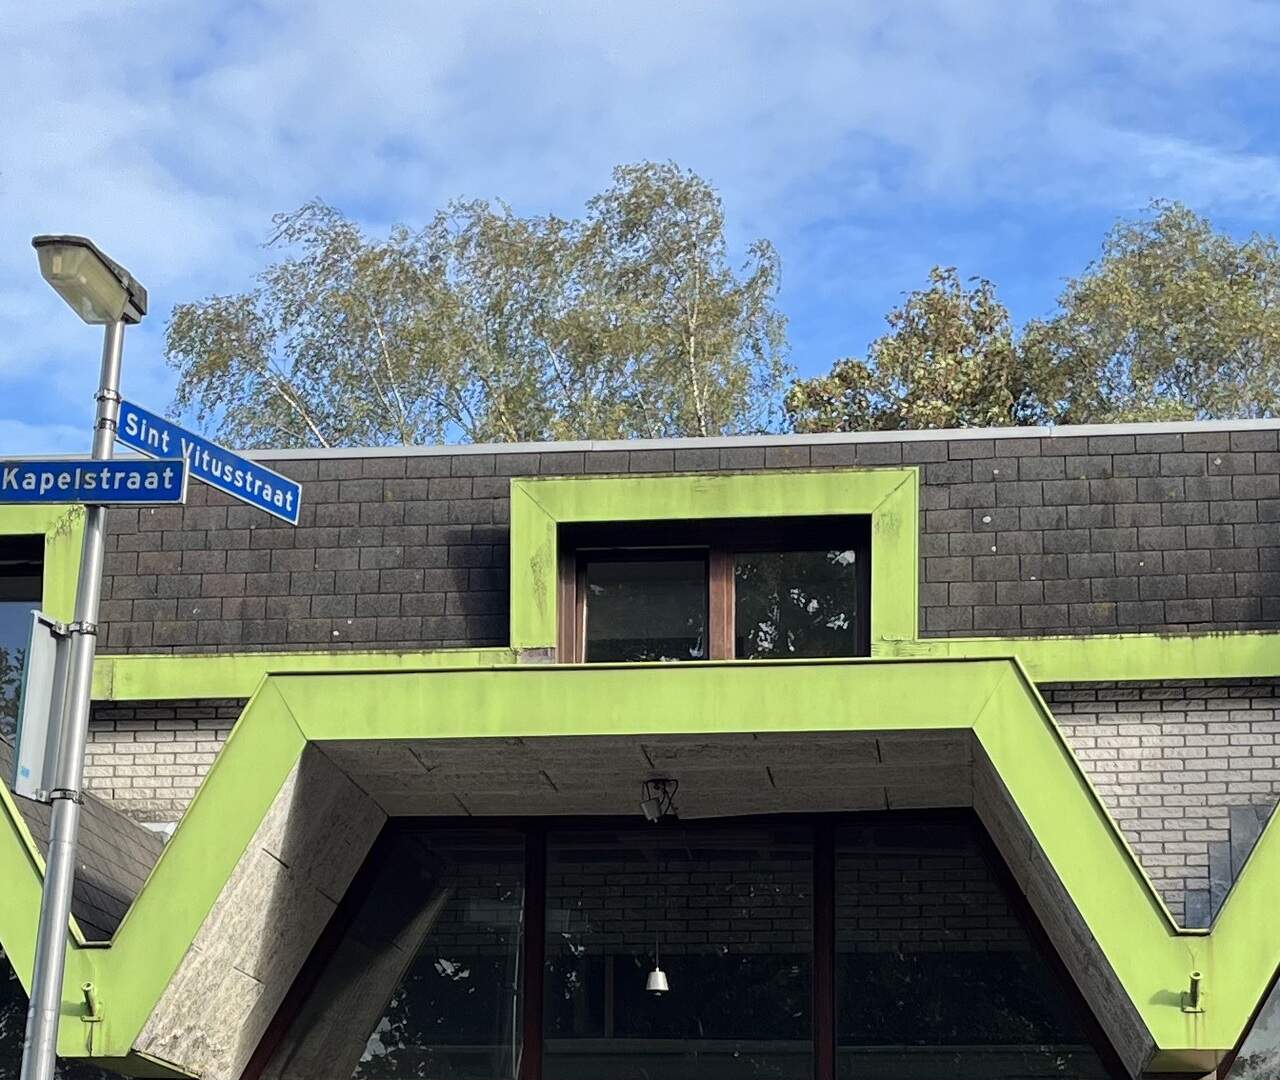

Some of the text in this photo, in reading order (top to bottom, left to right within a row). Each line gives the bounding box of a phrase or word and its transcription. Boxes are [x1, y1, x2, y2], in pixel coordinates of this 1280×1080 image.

[1, 466, 174, 495] Kapelstraat
[125, 412, 294, 512] Sint Vitusstraat
